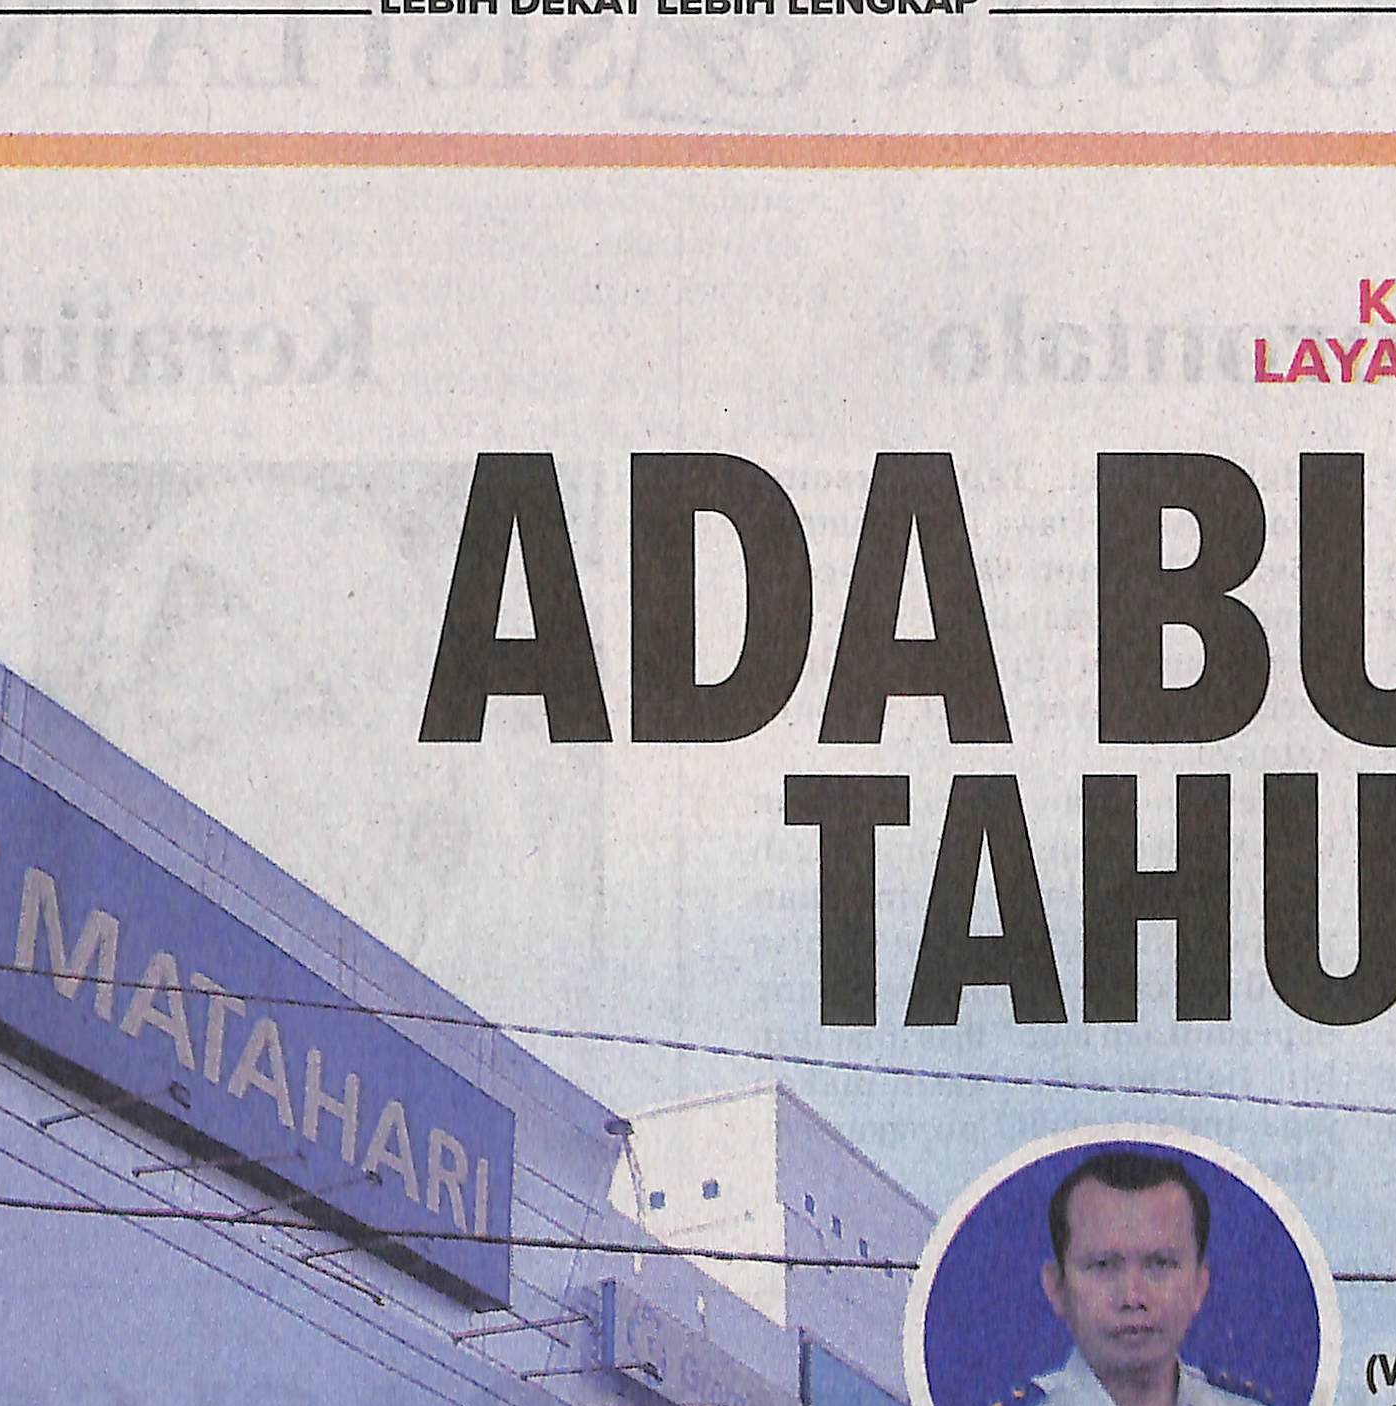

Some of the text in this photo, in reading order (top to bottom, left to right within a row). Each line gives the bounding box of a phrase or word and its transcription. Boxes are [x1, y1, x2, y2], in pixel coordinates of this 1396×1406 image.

[381, 0, 978, 15] LEBIH DEKAT LEBIH LENGKAP
[418, 452, 1014, 745] ADA
[14, 867, 490, 1235] MATAHARI
